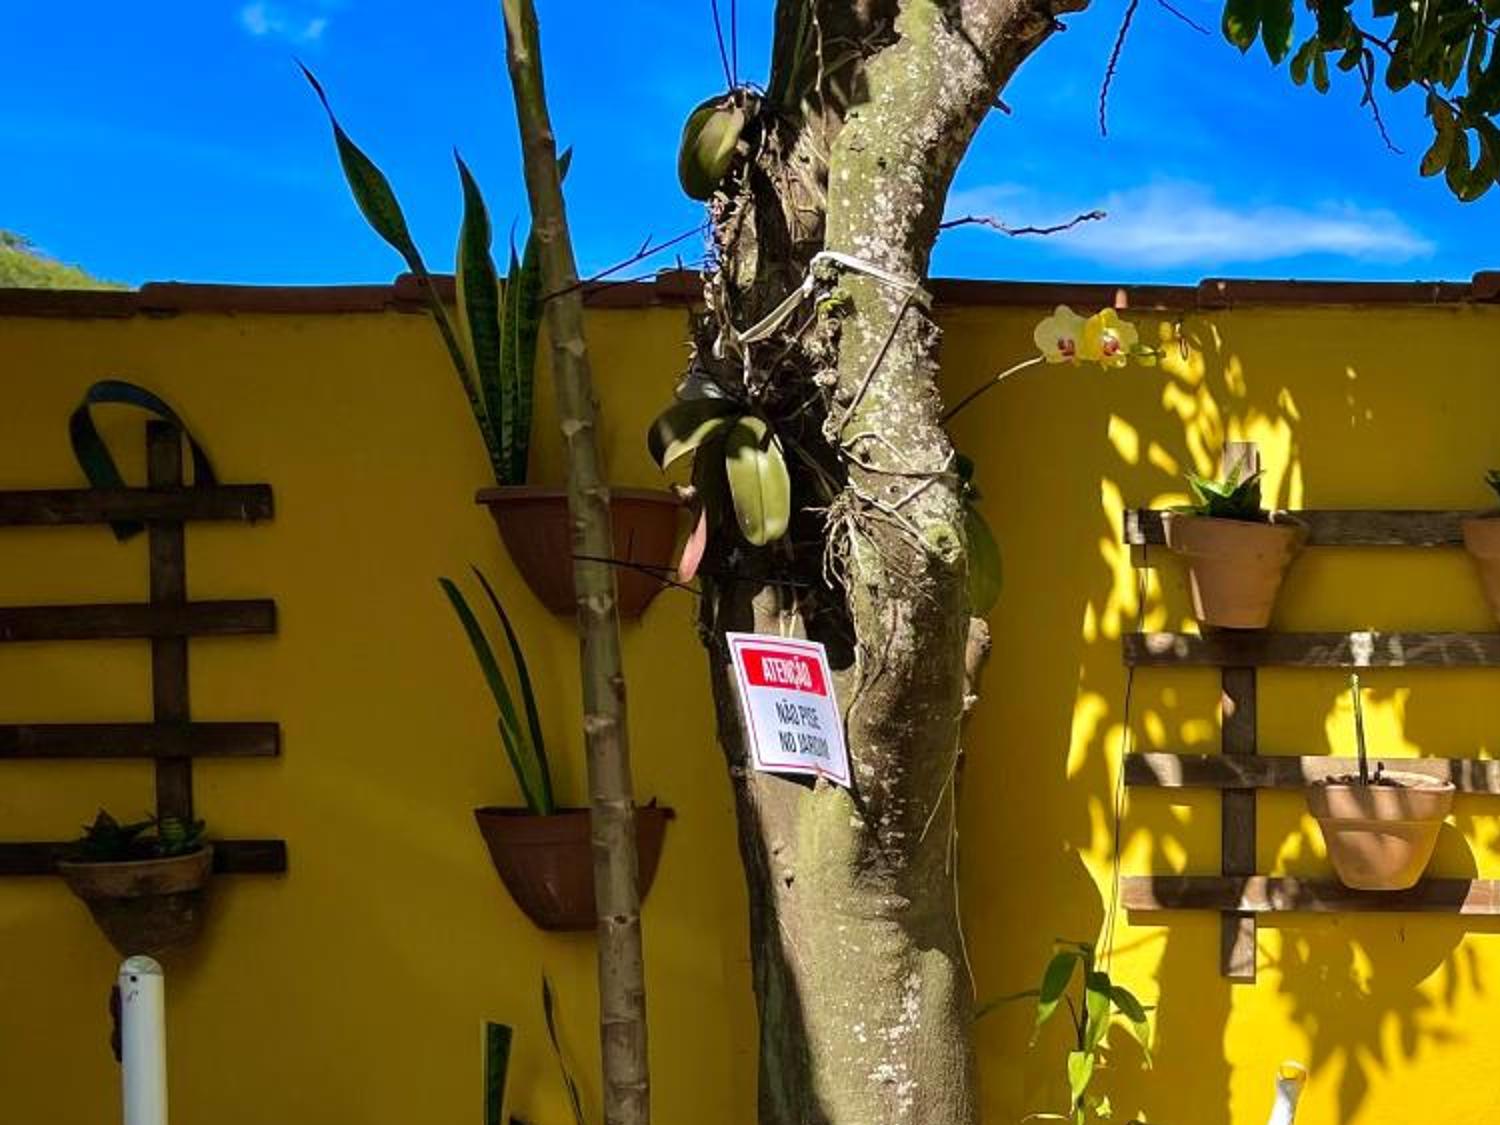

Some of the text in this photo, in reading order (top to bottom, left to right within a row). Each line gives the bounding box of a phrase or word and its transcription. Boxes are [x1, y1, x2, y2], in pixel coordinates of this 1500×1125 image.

[761, 656, 812, 689] ATENÇÃO
[776, 699, 821, 730] NÃO PISE
[778, 731, 797, 753] NO
